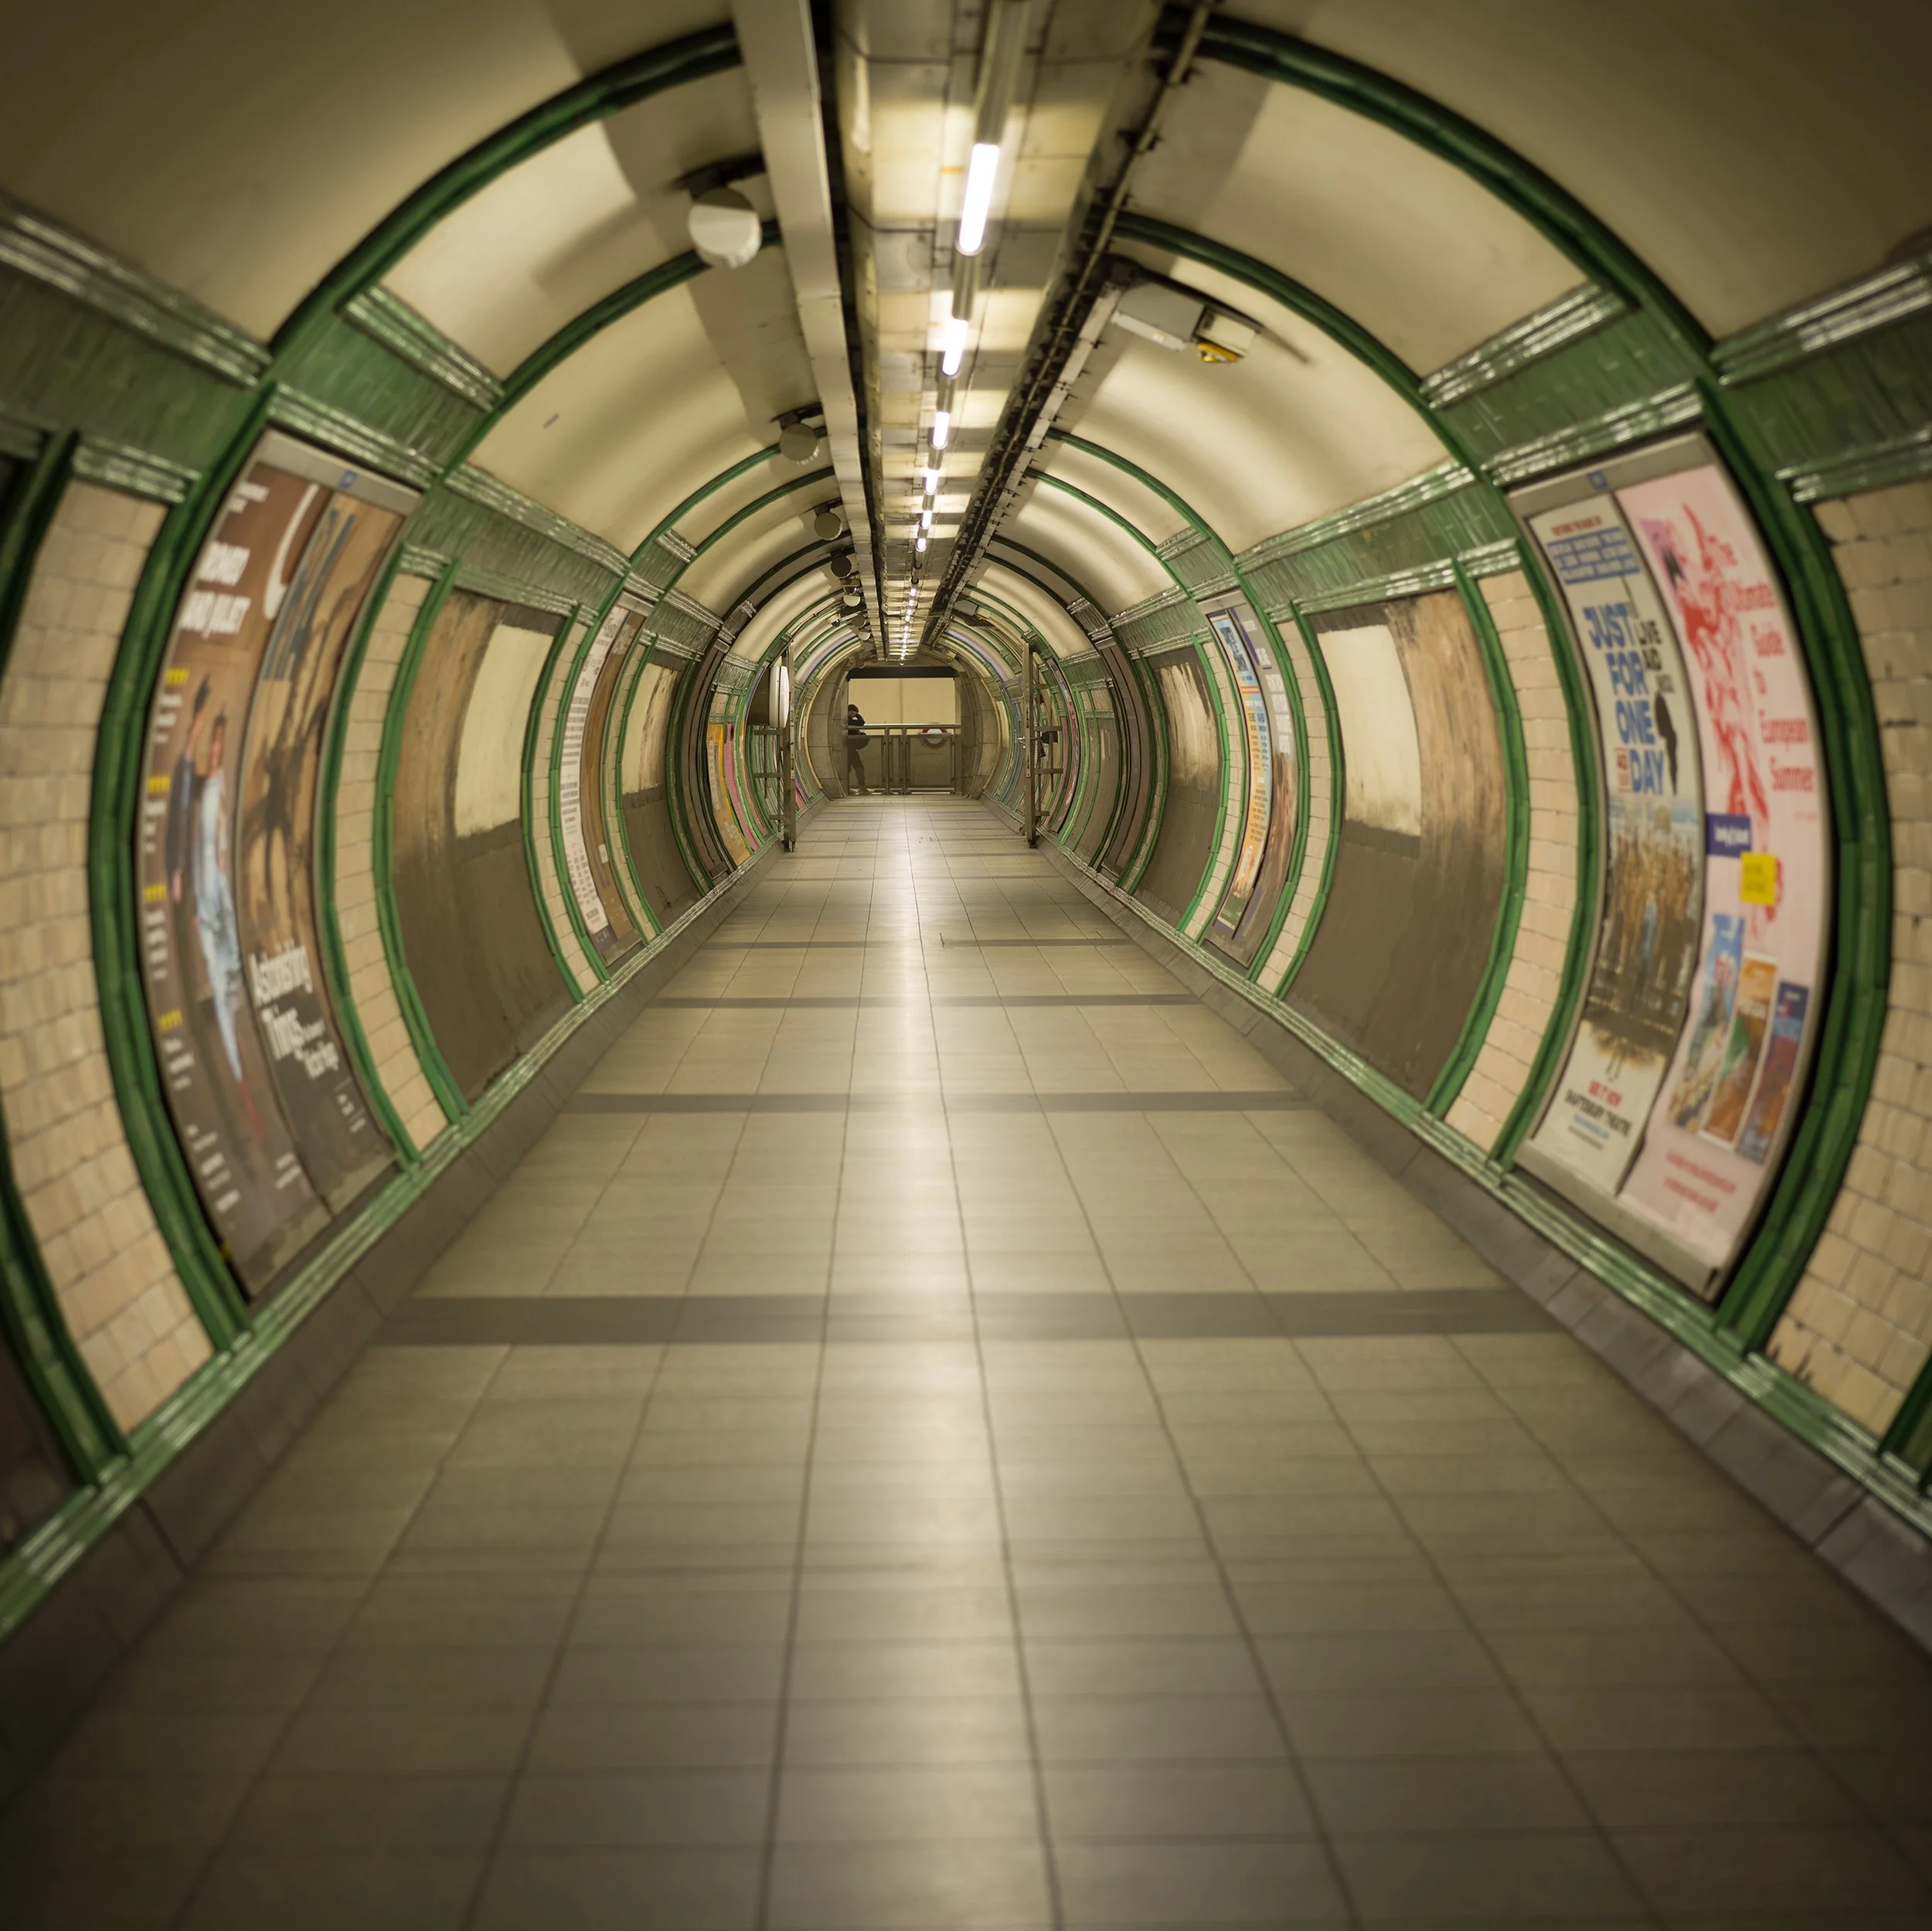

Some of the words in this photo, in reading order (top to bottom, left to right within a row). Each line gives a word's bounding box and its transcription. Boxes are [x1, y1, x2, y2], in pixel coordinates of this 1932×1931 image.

[1583, 602, 1635, 649] JUST
[1639, 620, 1662, 645] LIVE
[1605, 650, 1649, 695] FOR
[1642, 647, 1663, 671] AID
[1615, 699, 1656, 746] ONE
[1758, 709, 1809, 753] European
[1630, 748, 1665, 795] DAY
[1770, 756, 1815, 792] Summer
